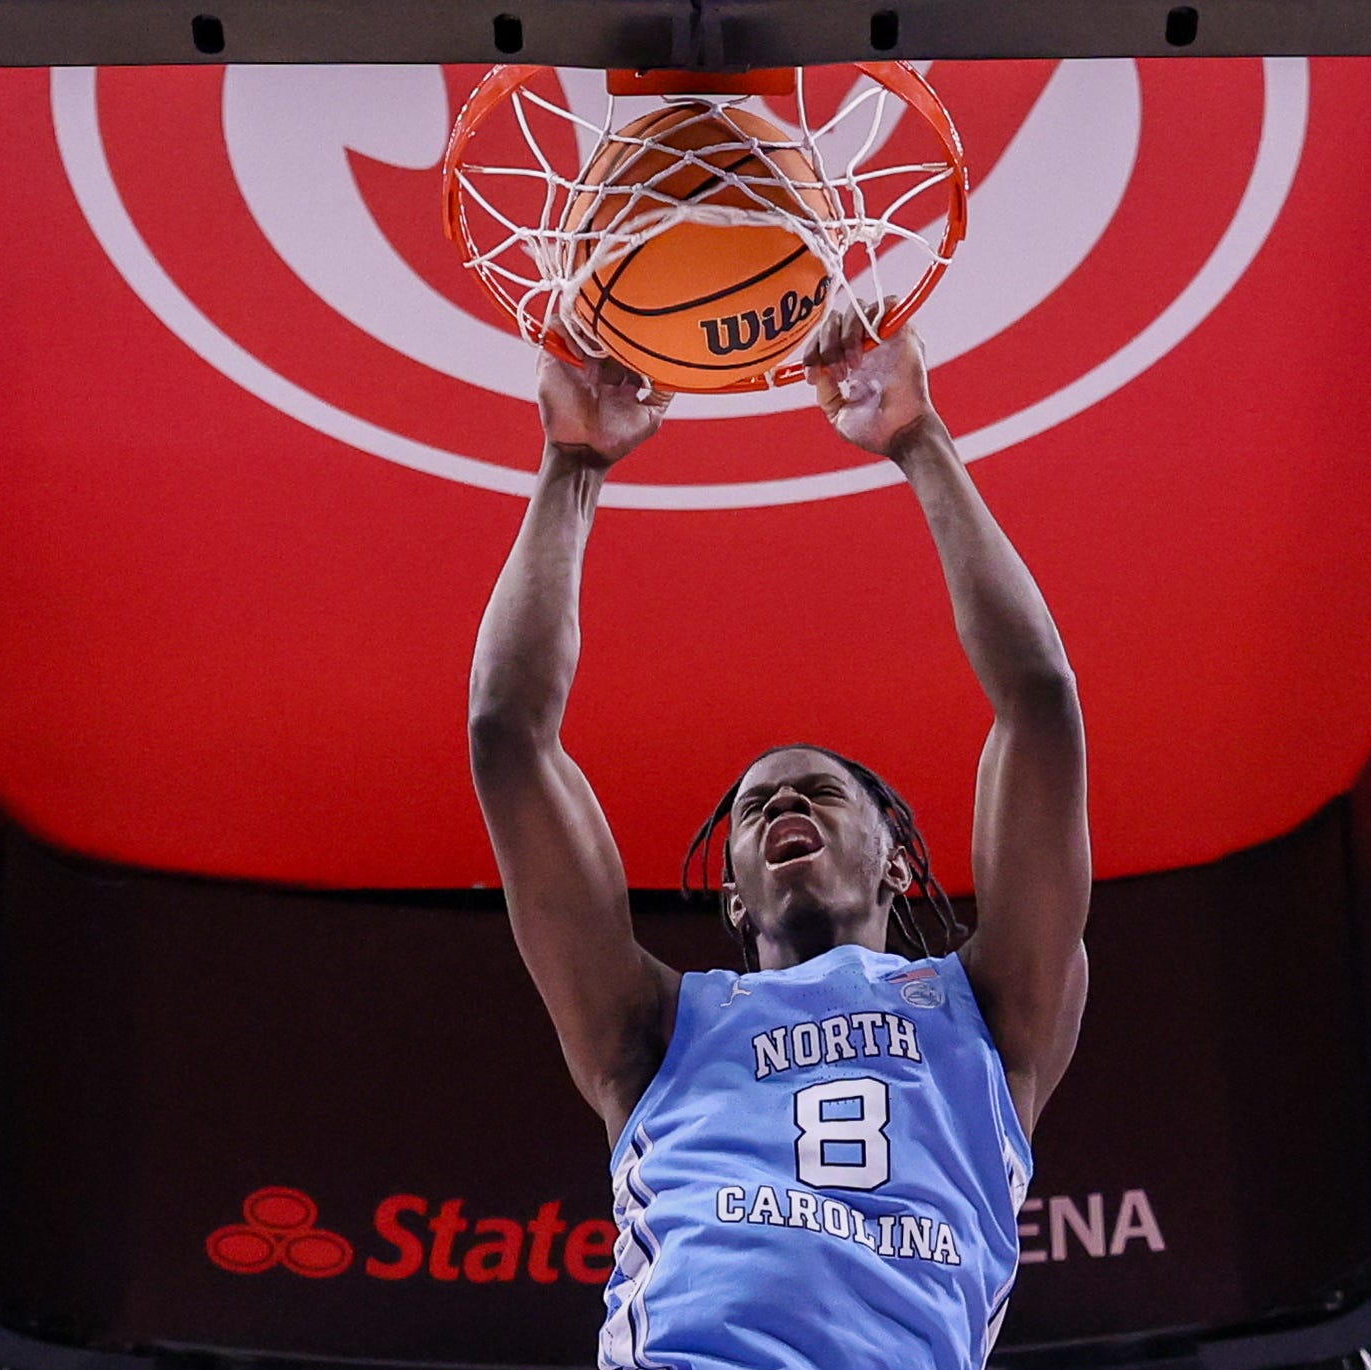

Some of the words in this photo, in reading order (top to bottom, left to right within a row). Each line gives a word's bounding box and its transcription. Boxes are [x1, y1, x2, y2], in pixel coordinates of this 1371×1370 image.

[752, 1011, 922, 1081] NORTH
[793, 1075, 891, 1192] 8
[365, 1193, 619, 1284] State
[716, 1184, 961, 1265] CAROLINA
